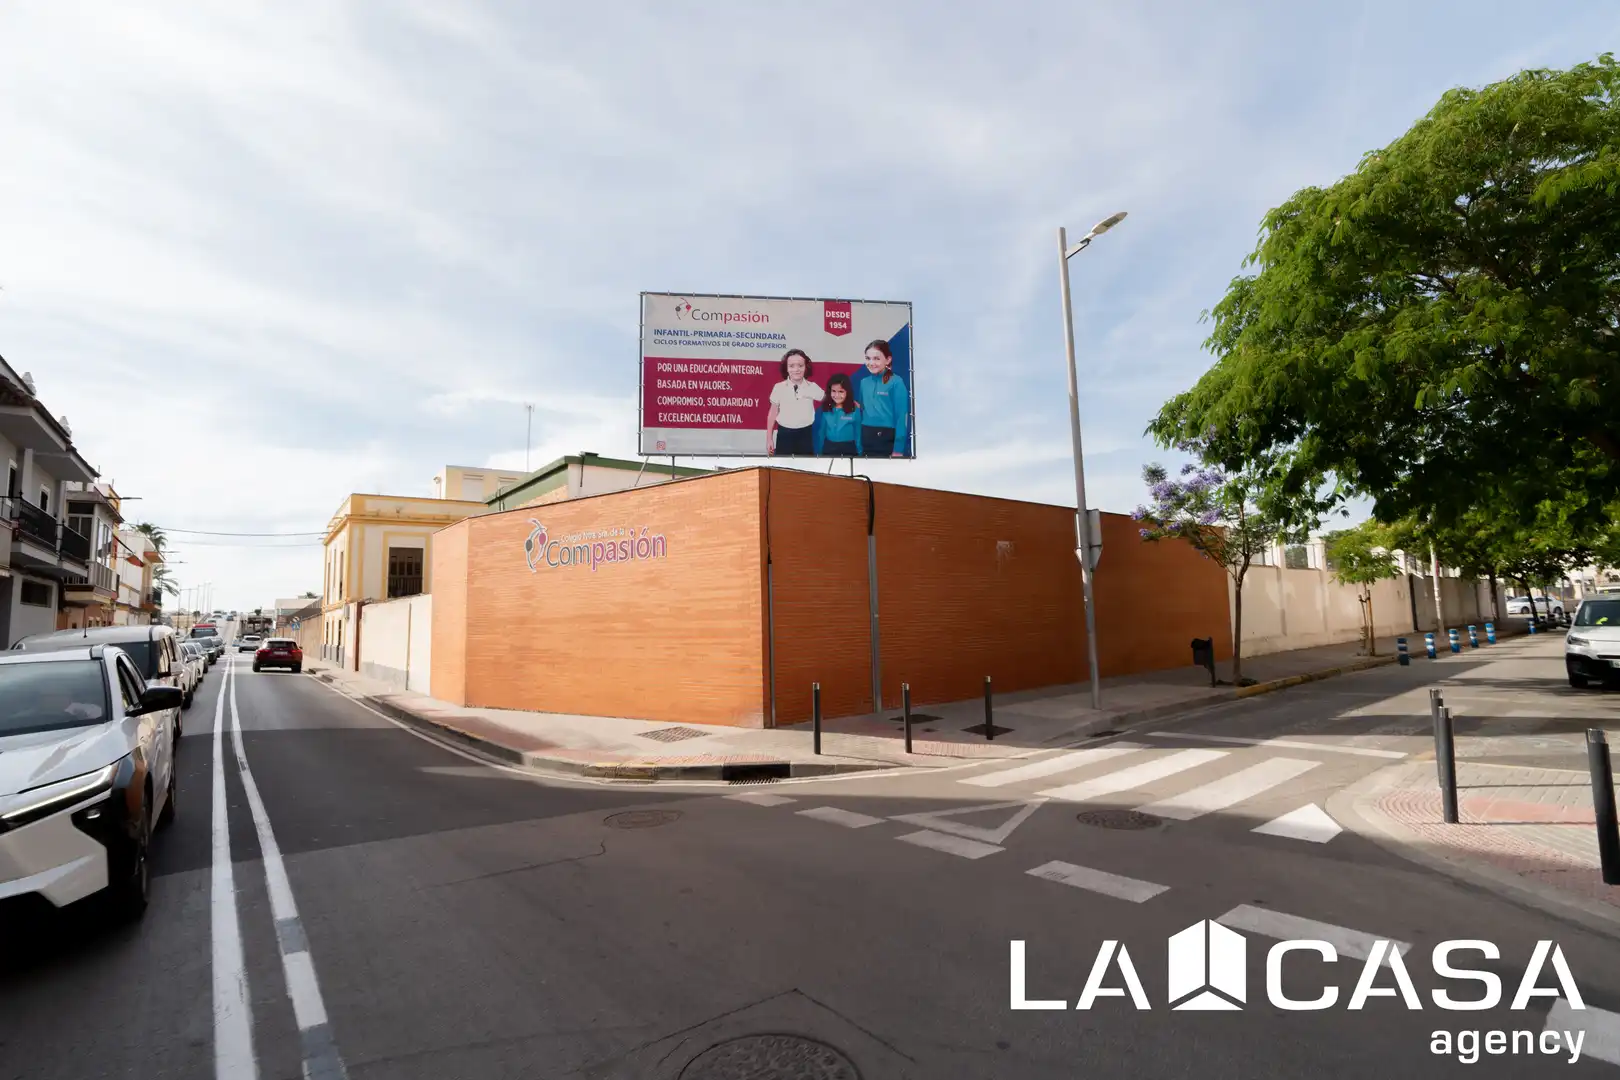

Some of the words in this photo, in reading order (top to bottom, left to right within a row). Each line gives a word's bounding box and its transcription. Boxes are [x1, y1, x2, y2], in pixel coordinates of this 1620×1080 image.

[691, 309, 769, 324] Compasión
[825, 310, 851, 319] DESDE
[829, 321, 847, 329] 1954
[653, 338, 677, 346] CICLOS
[679, 339, 721, 347] FORMATIVOS
[657, 363, 673, 372] POR
[673, 363, 689, 373] UNA
[690, 362, 730, 374] EDUCACIÓN
[731, 364, 763, 375] INTEGRAL
[657, 379, 687, 389] BASADA
[688, 381, 698, 390] EN
[707, 398, 754, 407] SOLIDARIDAD
[754, 398, 760, 407] Y
[658, 412, 701, 422] EXCELENCIA
[702, 413, 743, 424] EDUCATIVA.
[546, 526, 667, 572] Compasión
